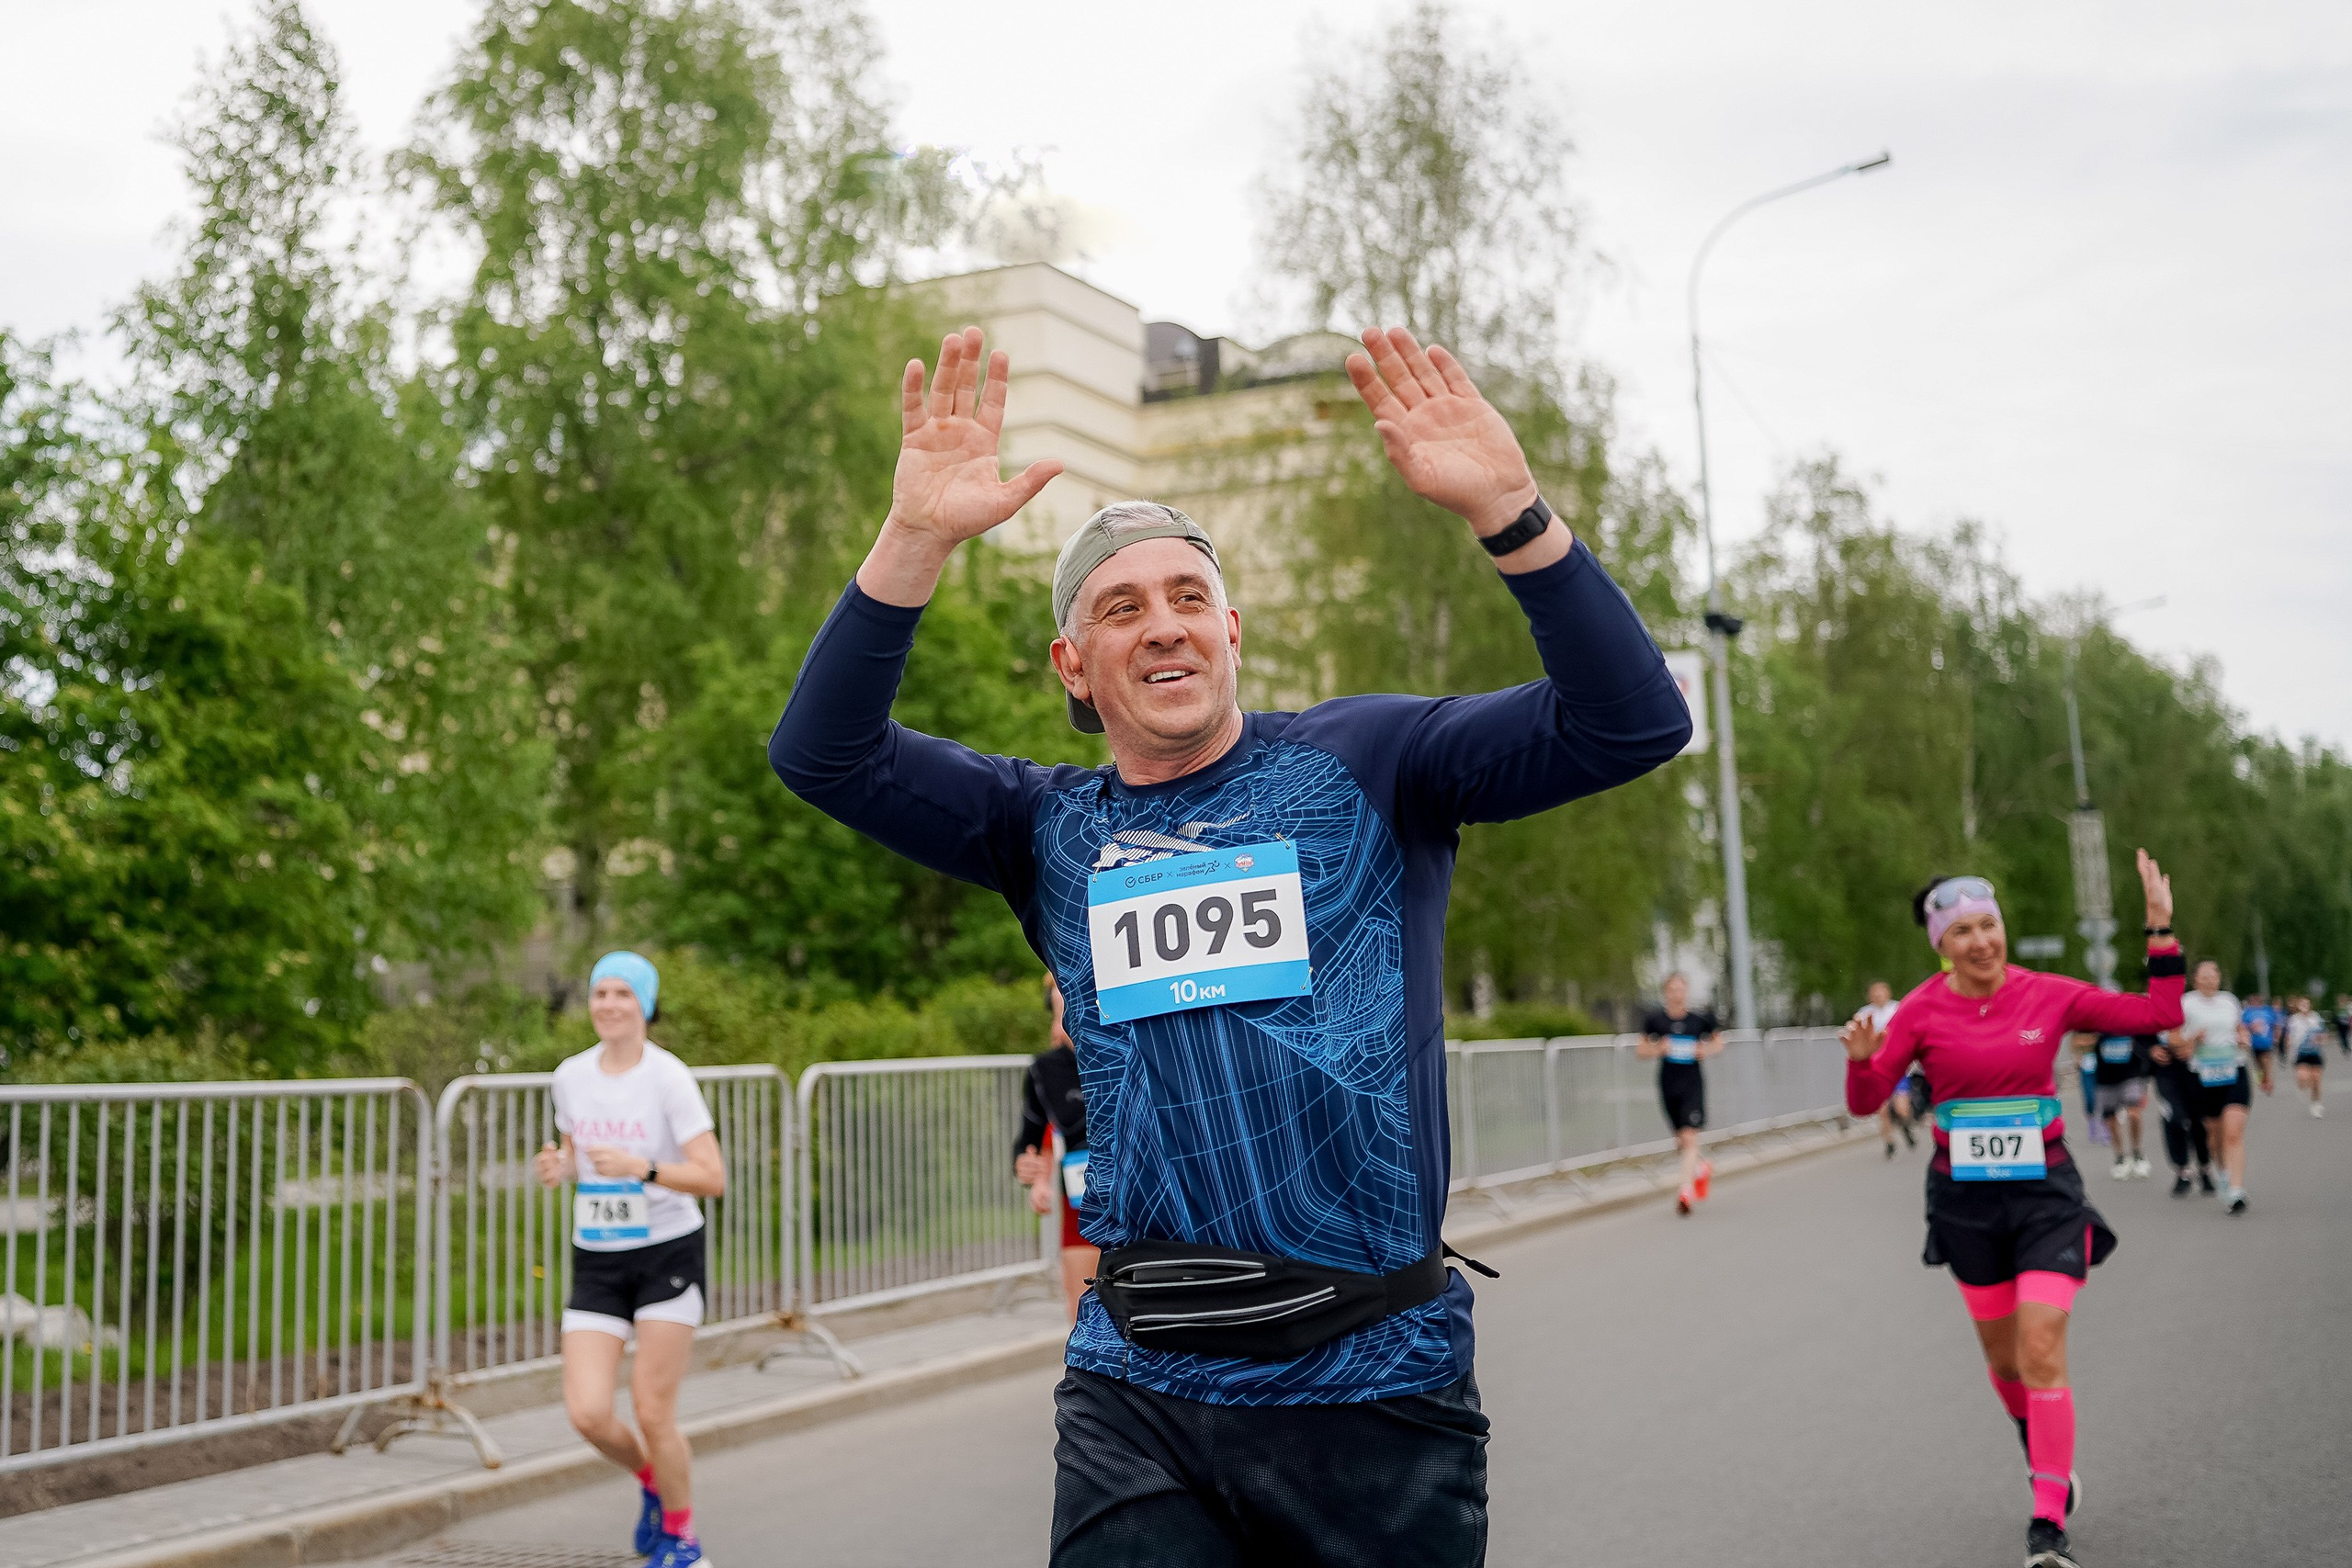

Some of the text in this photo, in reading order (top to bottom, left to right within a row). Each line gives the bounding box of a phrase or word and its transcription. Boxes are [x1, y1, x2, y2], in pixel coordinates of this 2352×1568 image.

[1137, 872, 1163, 885] СБЕР
[1114, 888, 1282, 969] 1095
[1970, 1134, 2022, 1158] 507
[589, 1199, 631, 1223] 768
